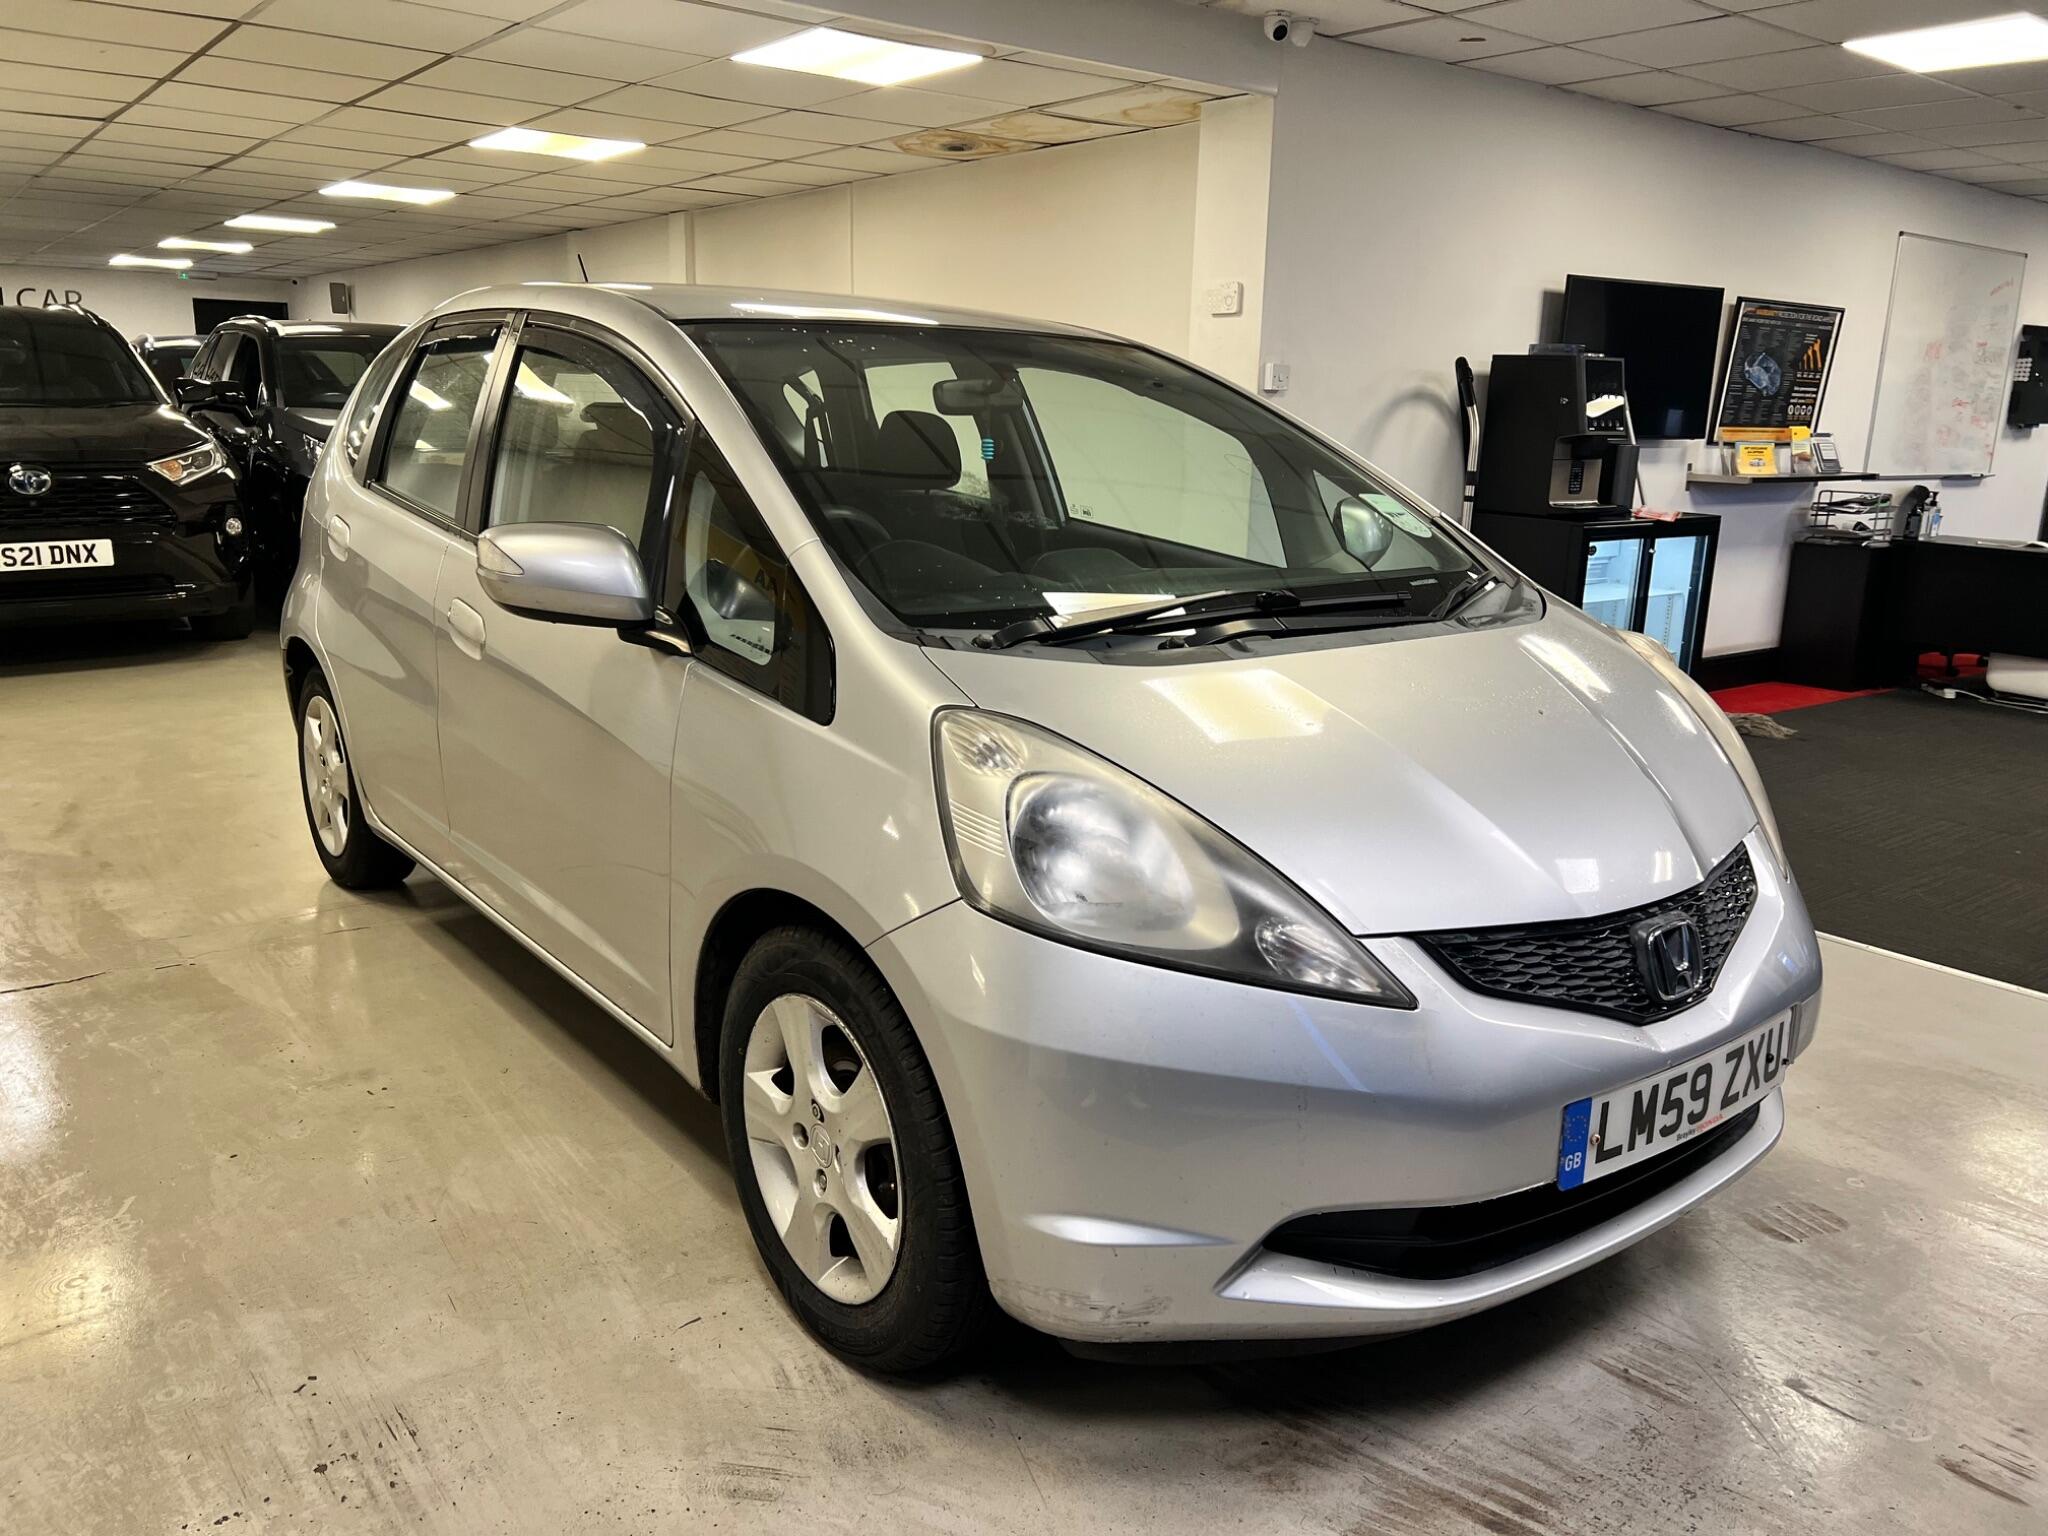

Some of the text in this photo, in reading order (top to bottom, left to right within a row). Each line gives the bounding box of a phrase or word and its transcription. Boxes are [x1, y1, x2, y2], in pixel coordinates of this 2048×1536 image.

[16, 287, 82, 309] CAR
[48, 543, 98, 565] DNX
[1594, 1021, 1785, 1164] LM59 ZXU
[1564, 1151, 1583, 1172] GB
